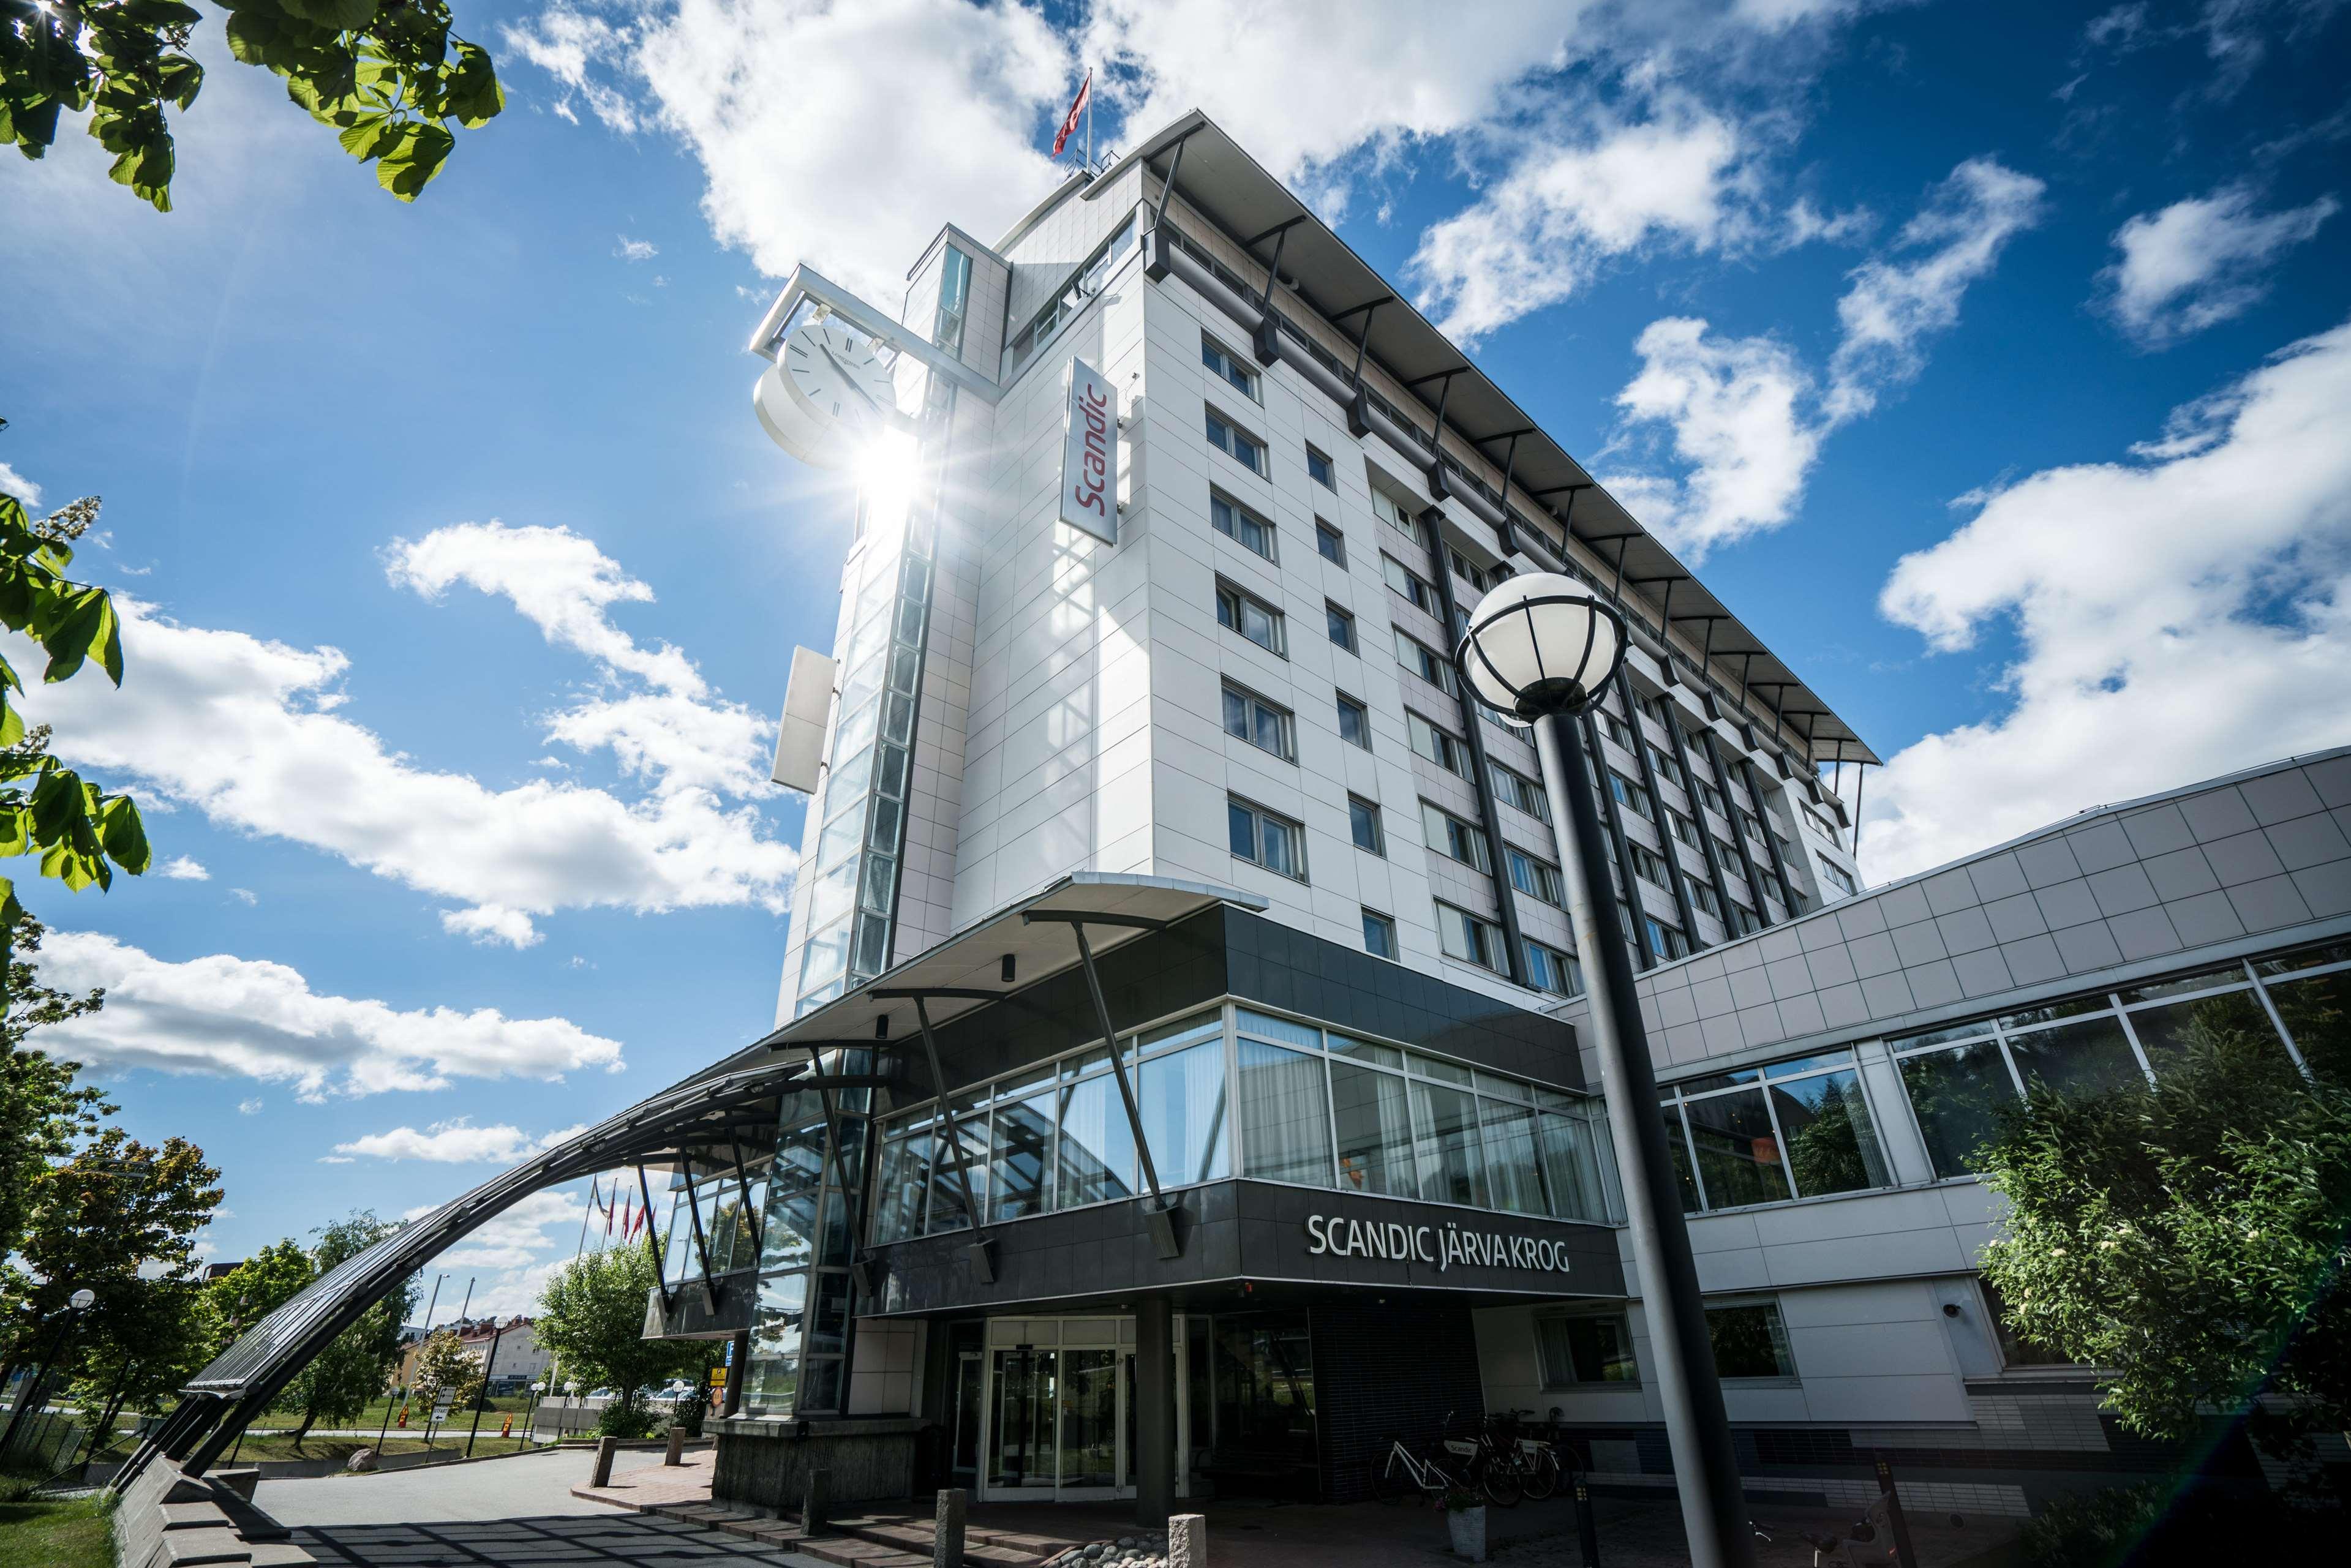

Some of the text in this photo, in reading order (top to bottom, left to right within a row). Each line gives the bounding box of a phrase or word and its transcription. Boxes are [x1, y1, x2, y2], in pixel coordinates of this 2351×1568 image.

[1075, 383, 1107, 517] Scandic
[1307, 1215, 1434, 1262] SCANDIC
[1450, 1445, 1473, 1454] Scandic
